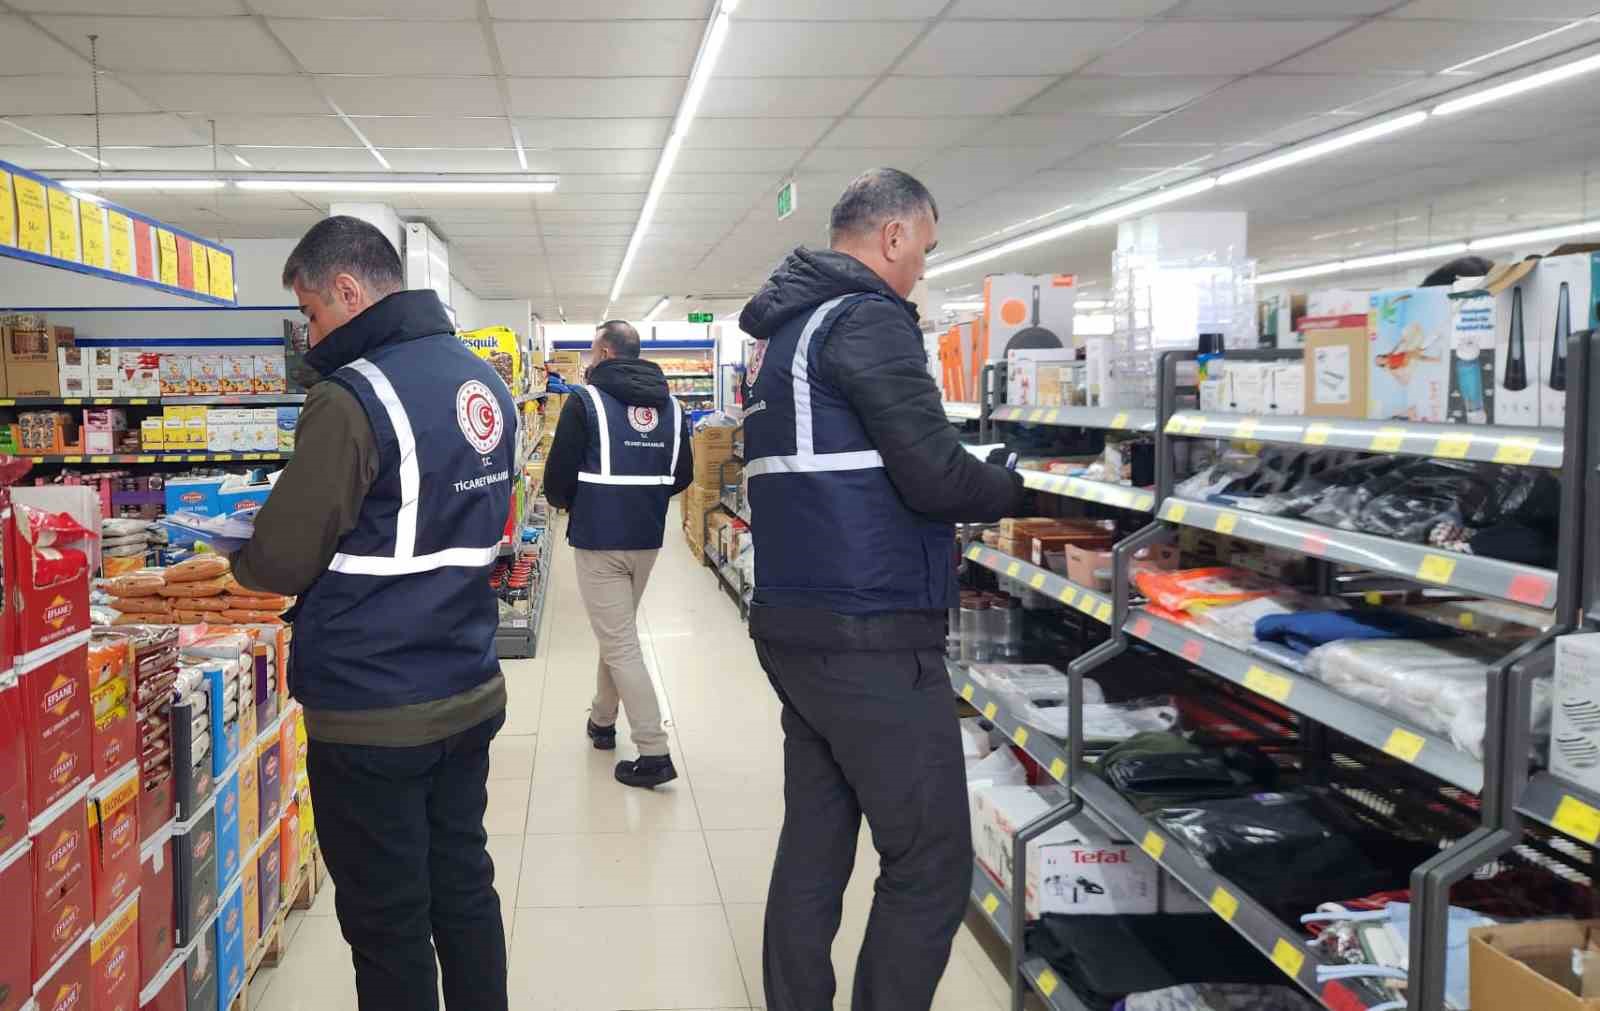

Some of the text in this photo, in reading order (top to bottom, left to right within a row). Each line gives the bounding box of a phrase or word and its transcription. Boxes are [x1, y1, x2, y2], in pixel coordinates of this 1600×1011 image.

[458, 335, 498, 350] esquik
[453, 476, 486, 492] TİCARET
[47, 684, 73, 707] EFSANE
[1071, 848, 1132, 864] Tefal
